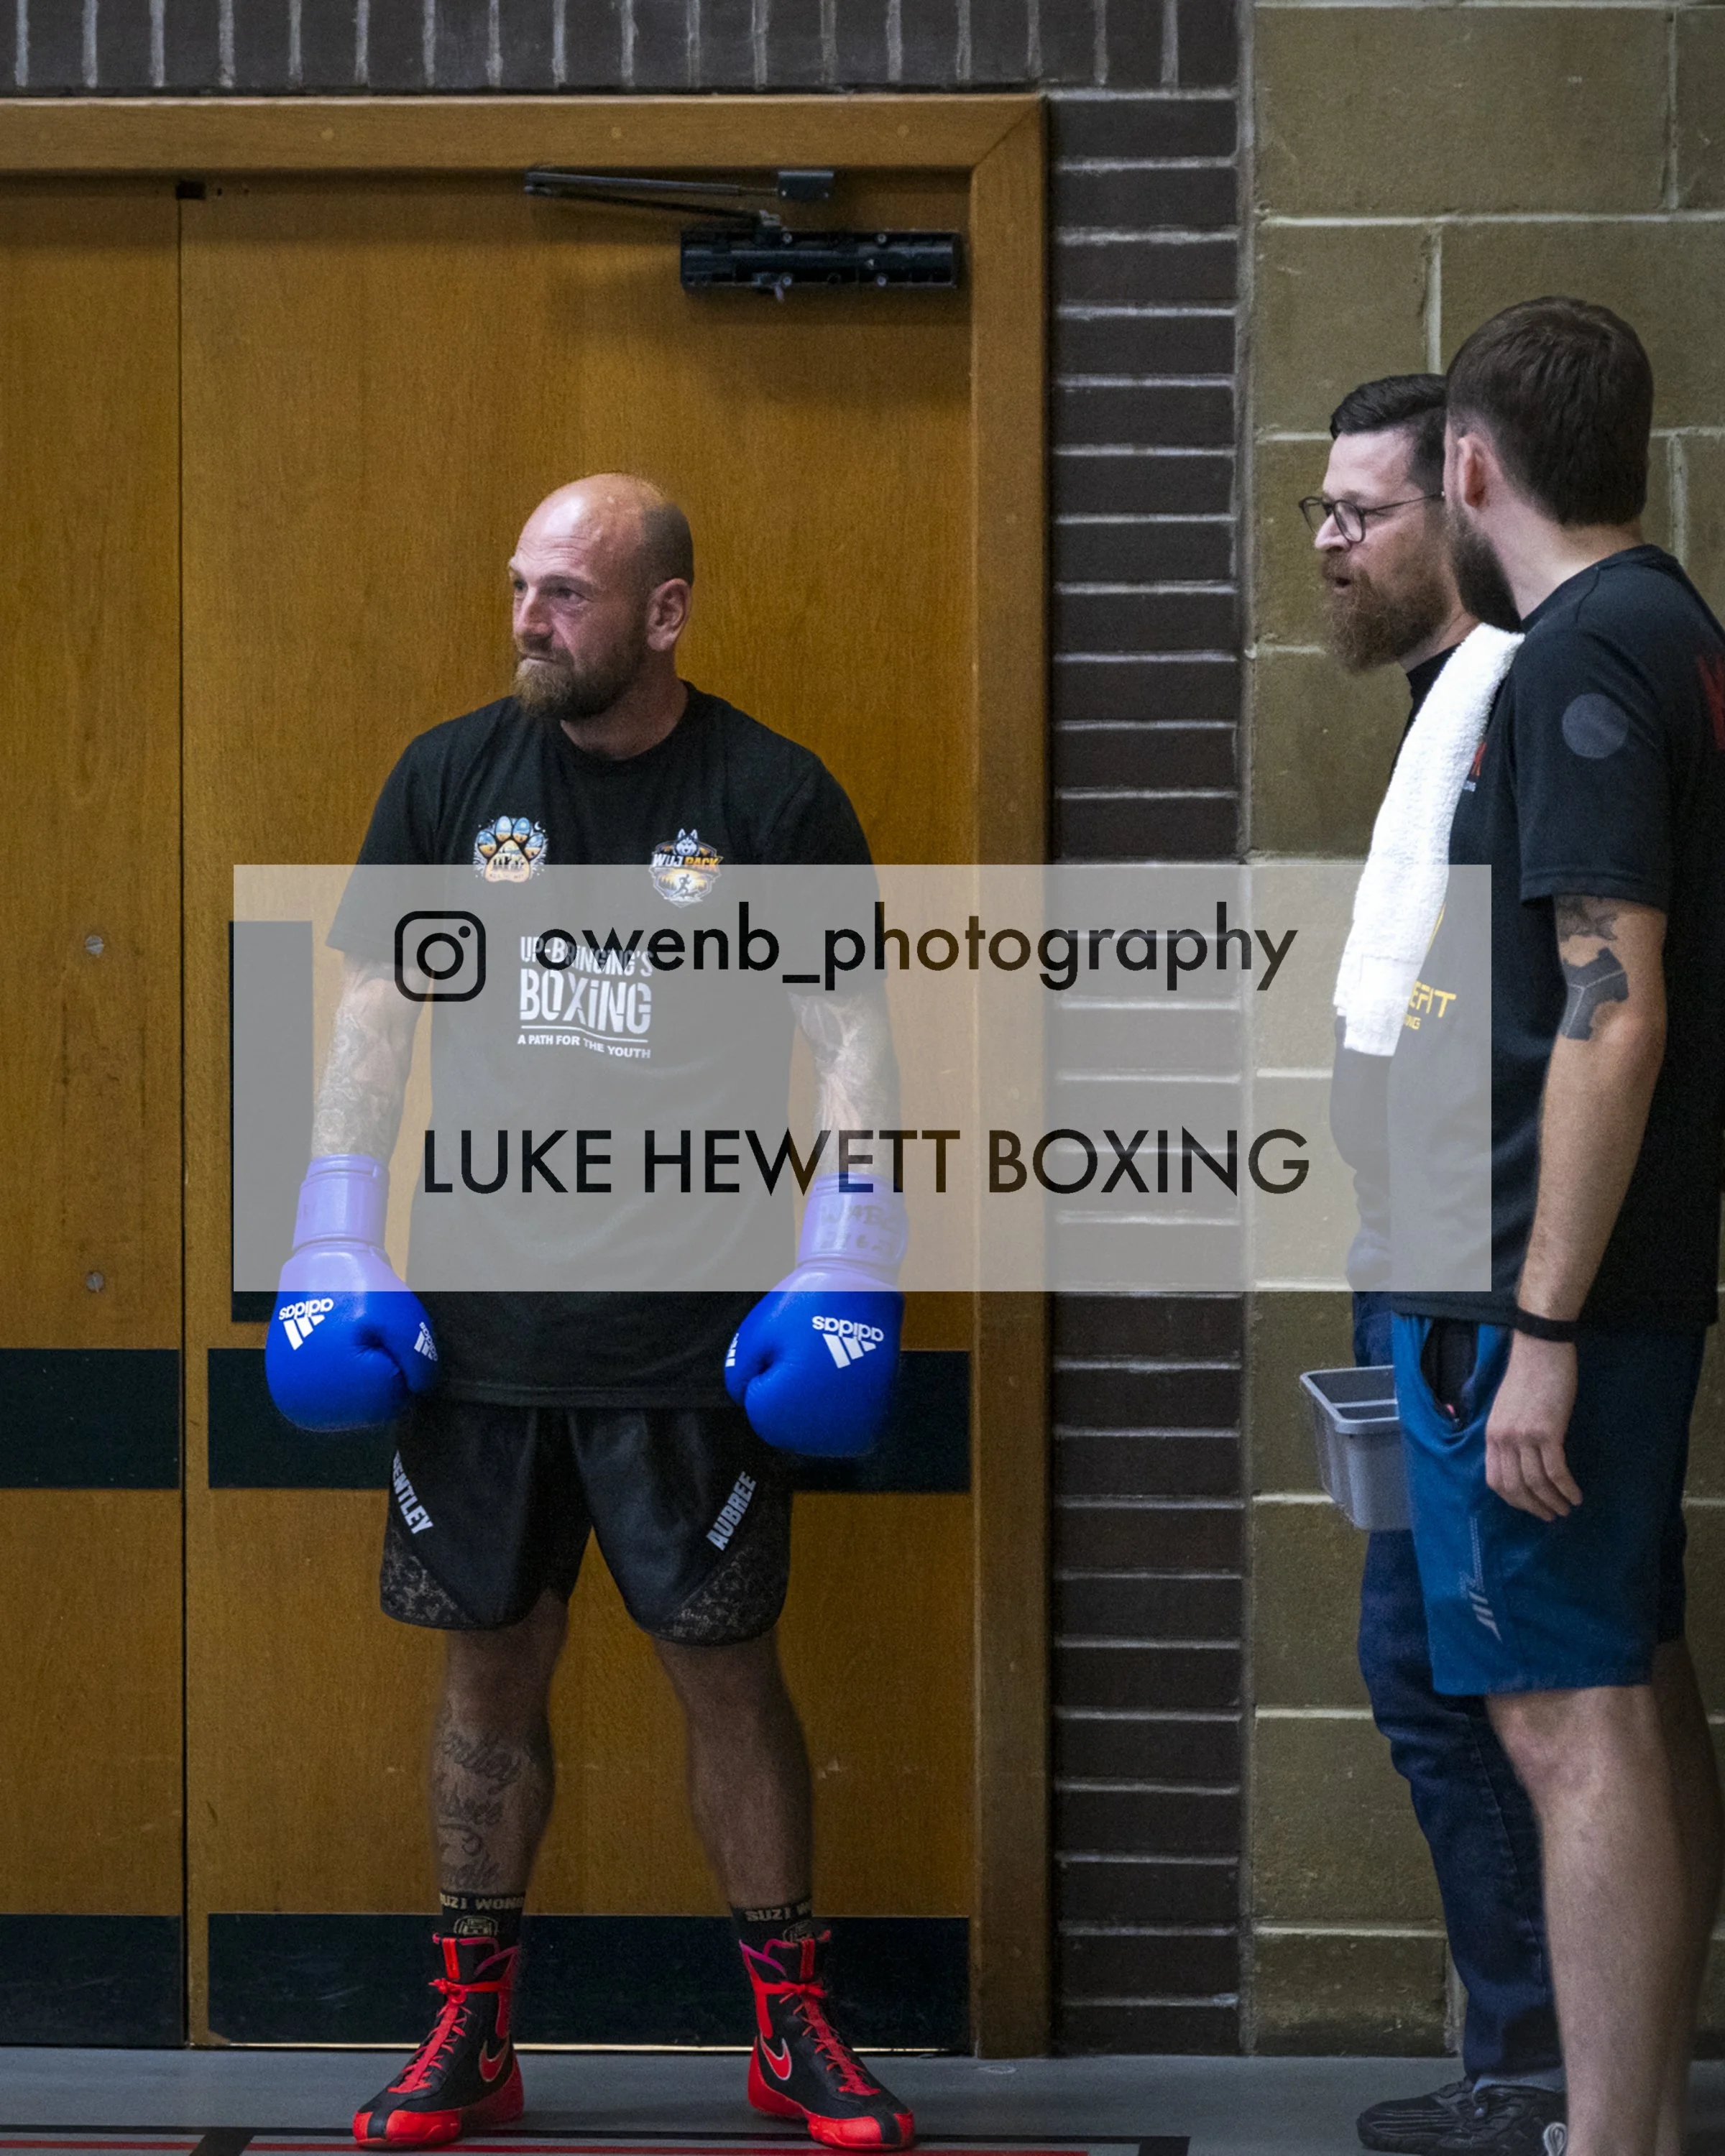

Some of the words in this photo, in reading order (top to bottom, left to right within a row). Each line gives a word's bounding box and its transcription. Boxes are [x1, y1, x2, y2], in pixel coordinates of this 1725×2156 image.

[684, 856, 719, 871] PACK
[518, 1034, 526, 1044] A
[528, 1035, 553, 1045] PATH
[556, 1035, 580, 1046] FOR
[583, 1038, 604, 1052] THE
[607, 1045, 651, 1059] YOUTH
[278, 1297, 334, 1321] adidas
[811, 1315, 885, 1342] adidas
[707, 1471, 756, 1551] AUBREE
[745, 1907, 791, 1922] SUZI
